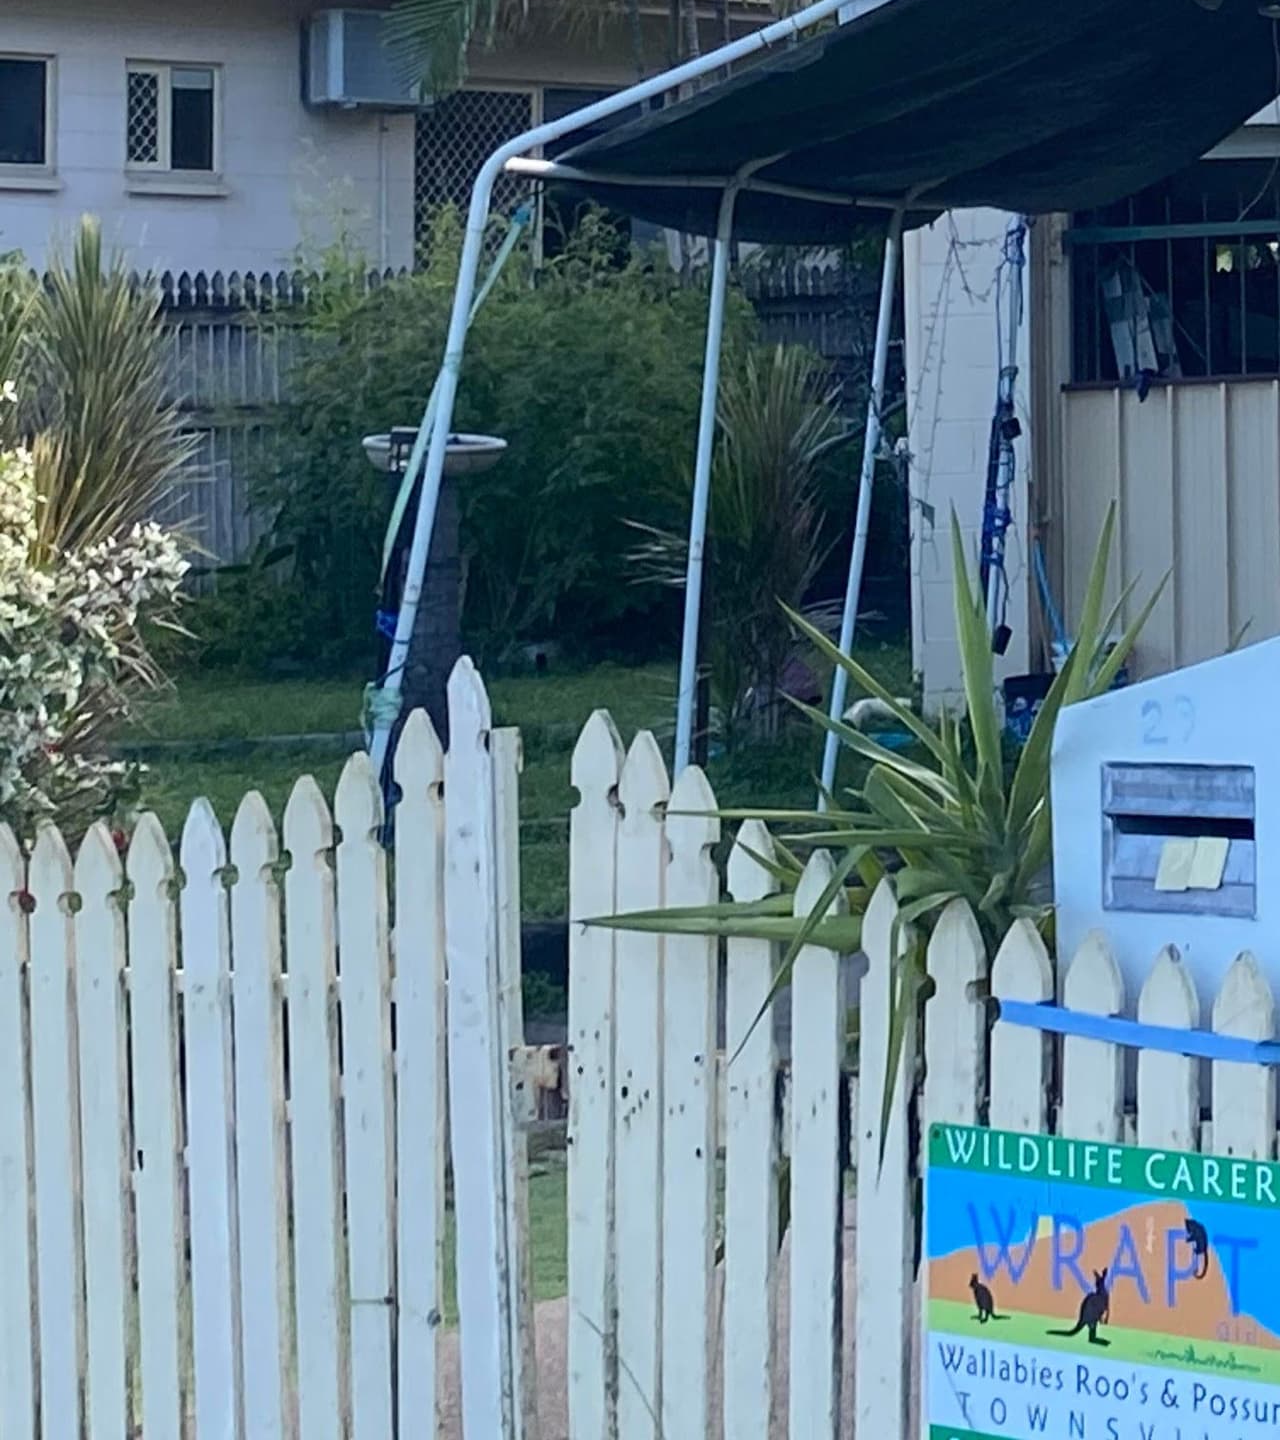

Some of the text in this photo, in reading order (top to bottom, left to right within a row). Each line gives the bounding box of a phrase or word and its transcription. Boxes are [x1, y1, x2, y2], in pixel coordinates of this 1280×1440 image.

[945, 1127, 1123, 1185] WILDLIFE
[966, 1199, 1260, 1318] WRAPT
[938, 1341, 1064, 1392] Wallabies
[1075, 1363, 1149, 1406] Roo's
[1160, 1377, 1181, 1409] &
[957, 1391, 1243, 1440] TOWNSV
